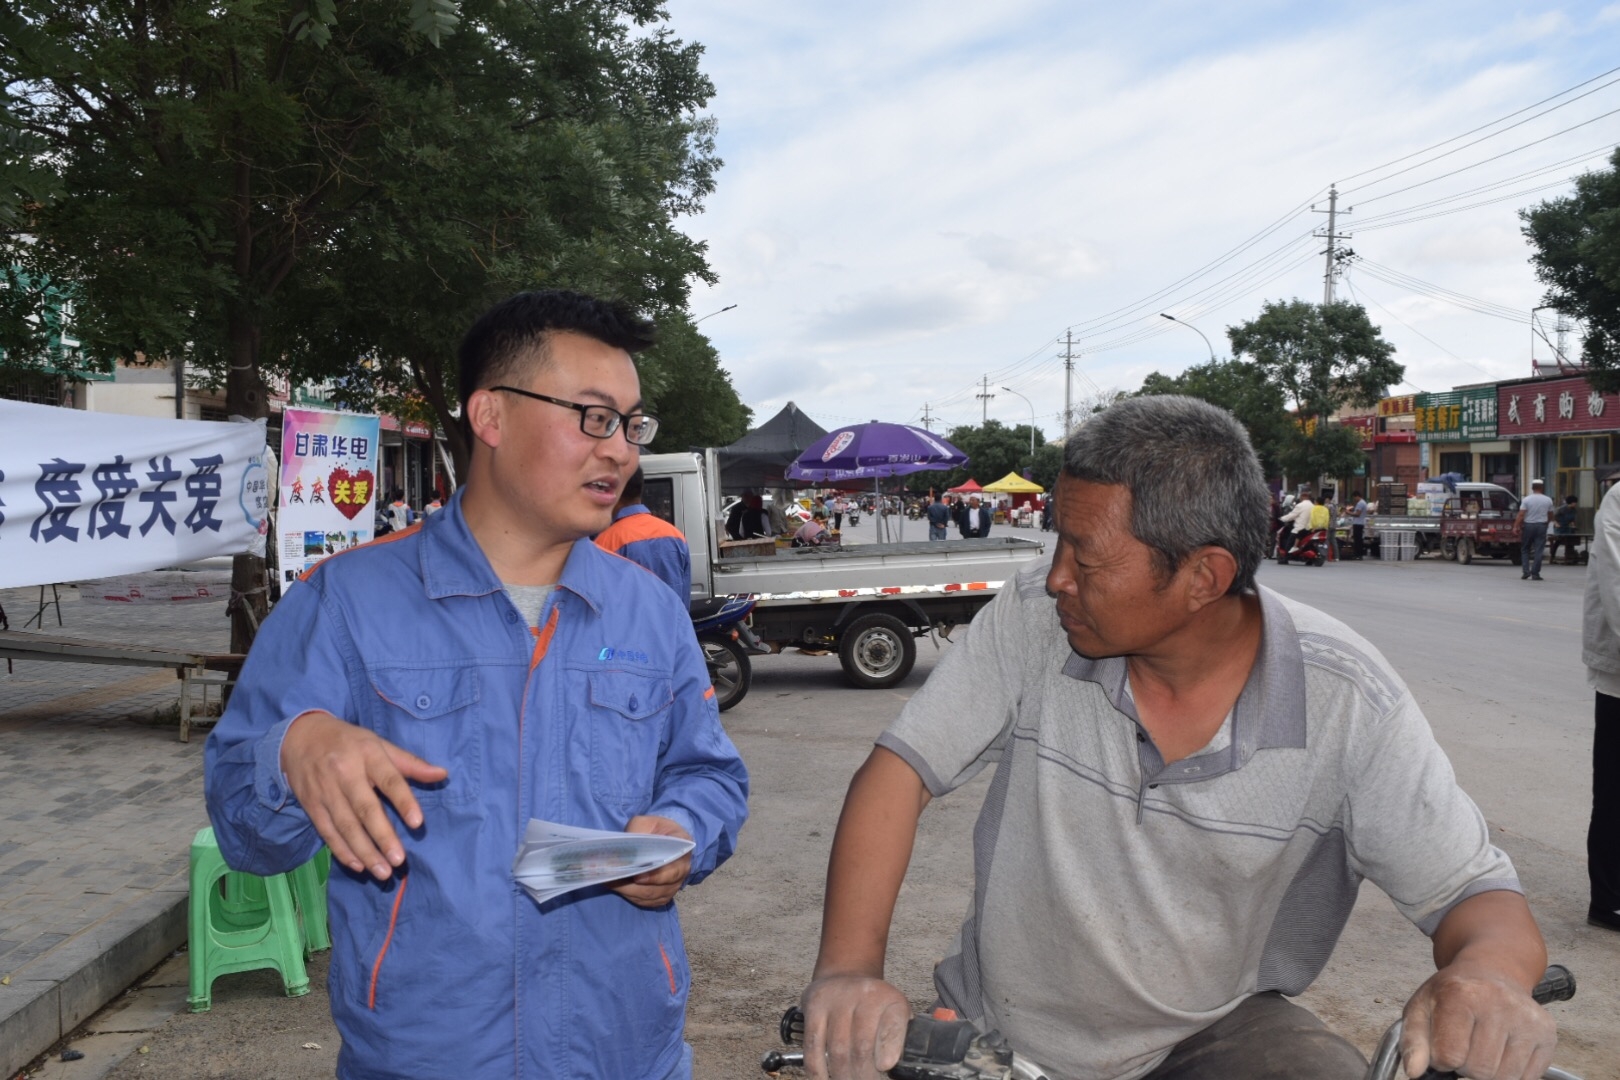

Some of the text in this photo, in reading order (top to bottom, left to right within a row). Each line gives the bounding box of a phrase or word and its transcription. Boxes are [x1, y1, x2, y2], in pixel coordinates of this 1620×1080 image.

[295, 433, 368, 460] 甘肃华电
[29, 453, 224, 543] 度度关爱
